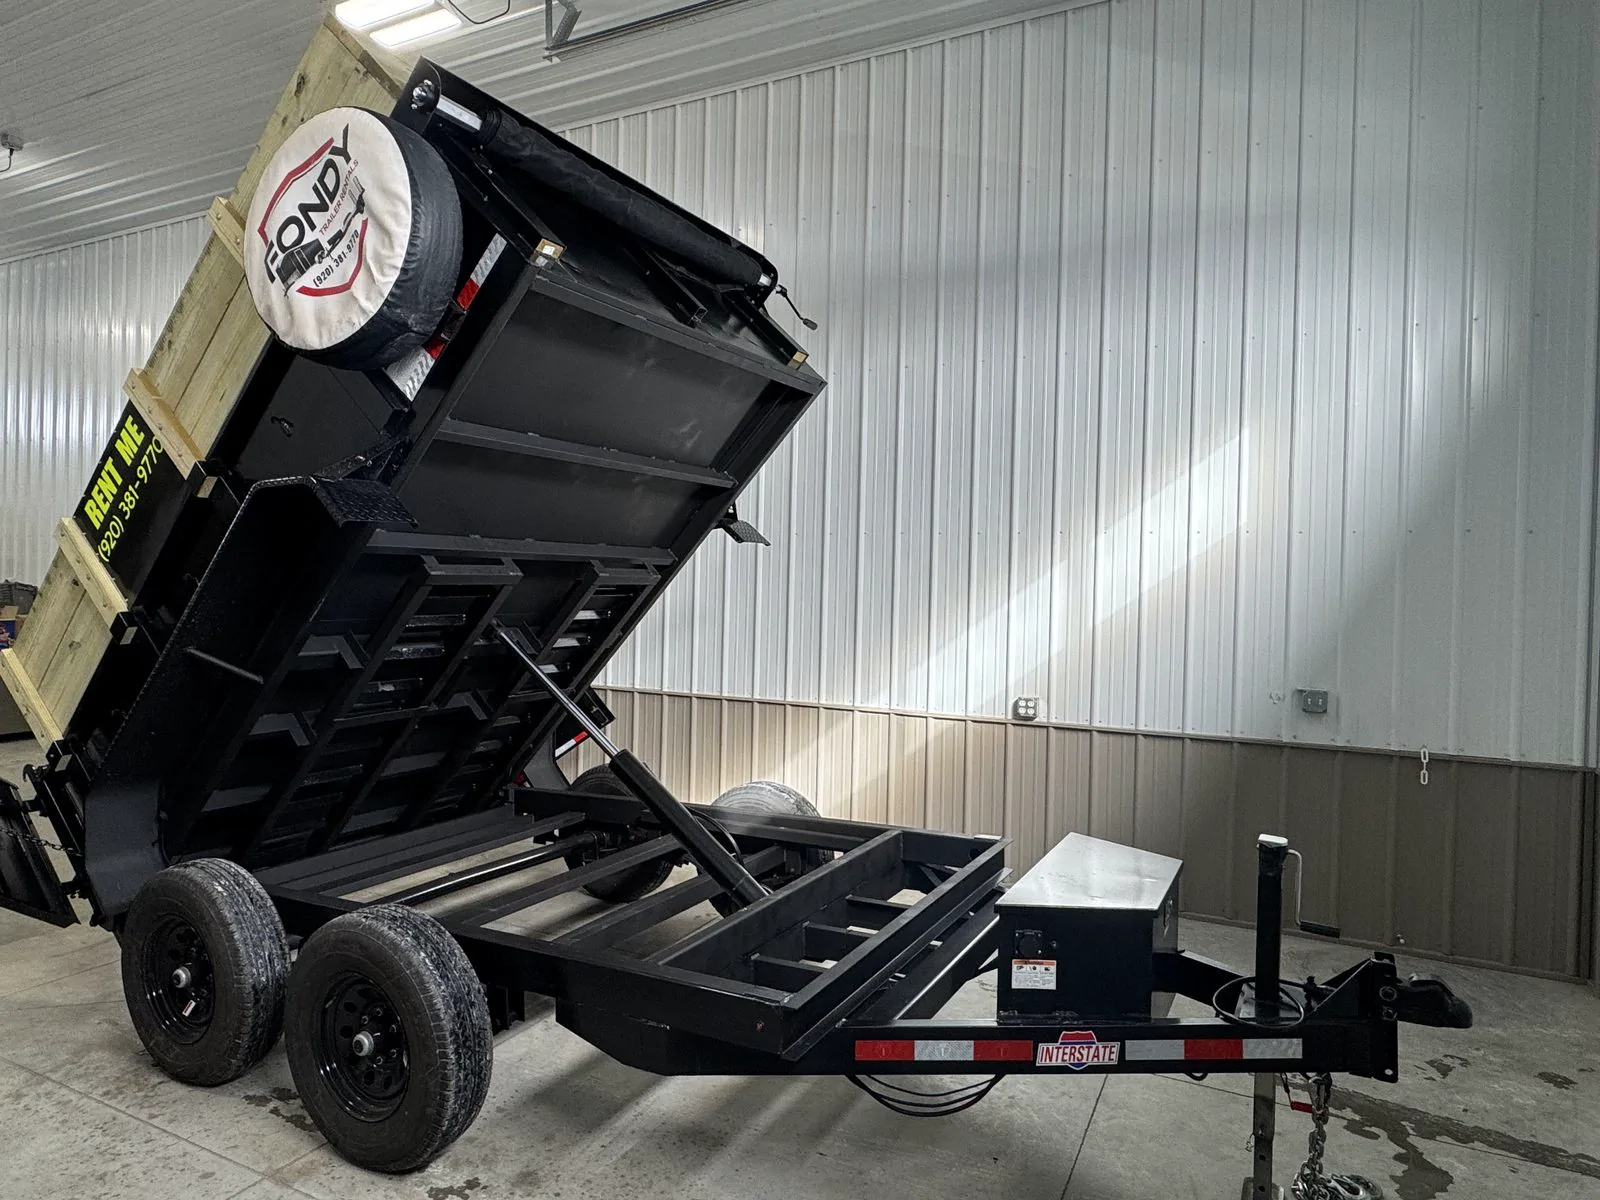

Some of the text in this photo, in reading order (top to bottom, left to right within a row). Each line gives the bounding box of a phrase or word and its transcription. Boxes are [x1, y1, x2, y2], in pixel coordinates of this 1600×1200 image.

[264, 123, 352, 283] FONDY
[319, 160, 359, 235] TRAILER RENTALS
[313, 229, 359, 287] (920) 381-9770
[84, 415, 145, 530] RENT ME
[98, 436, 164, 562] (920) 381-9770
[1040, 1045, 1116, 1062] INTERSTATE
